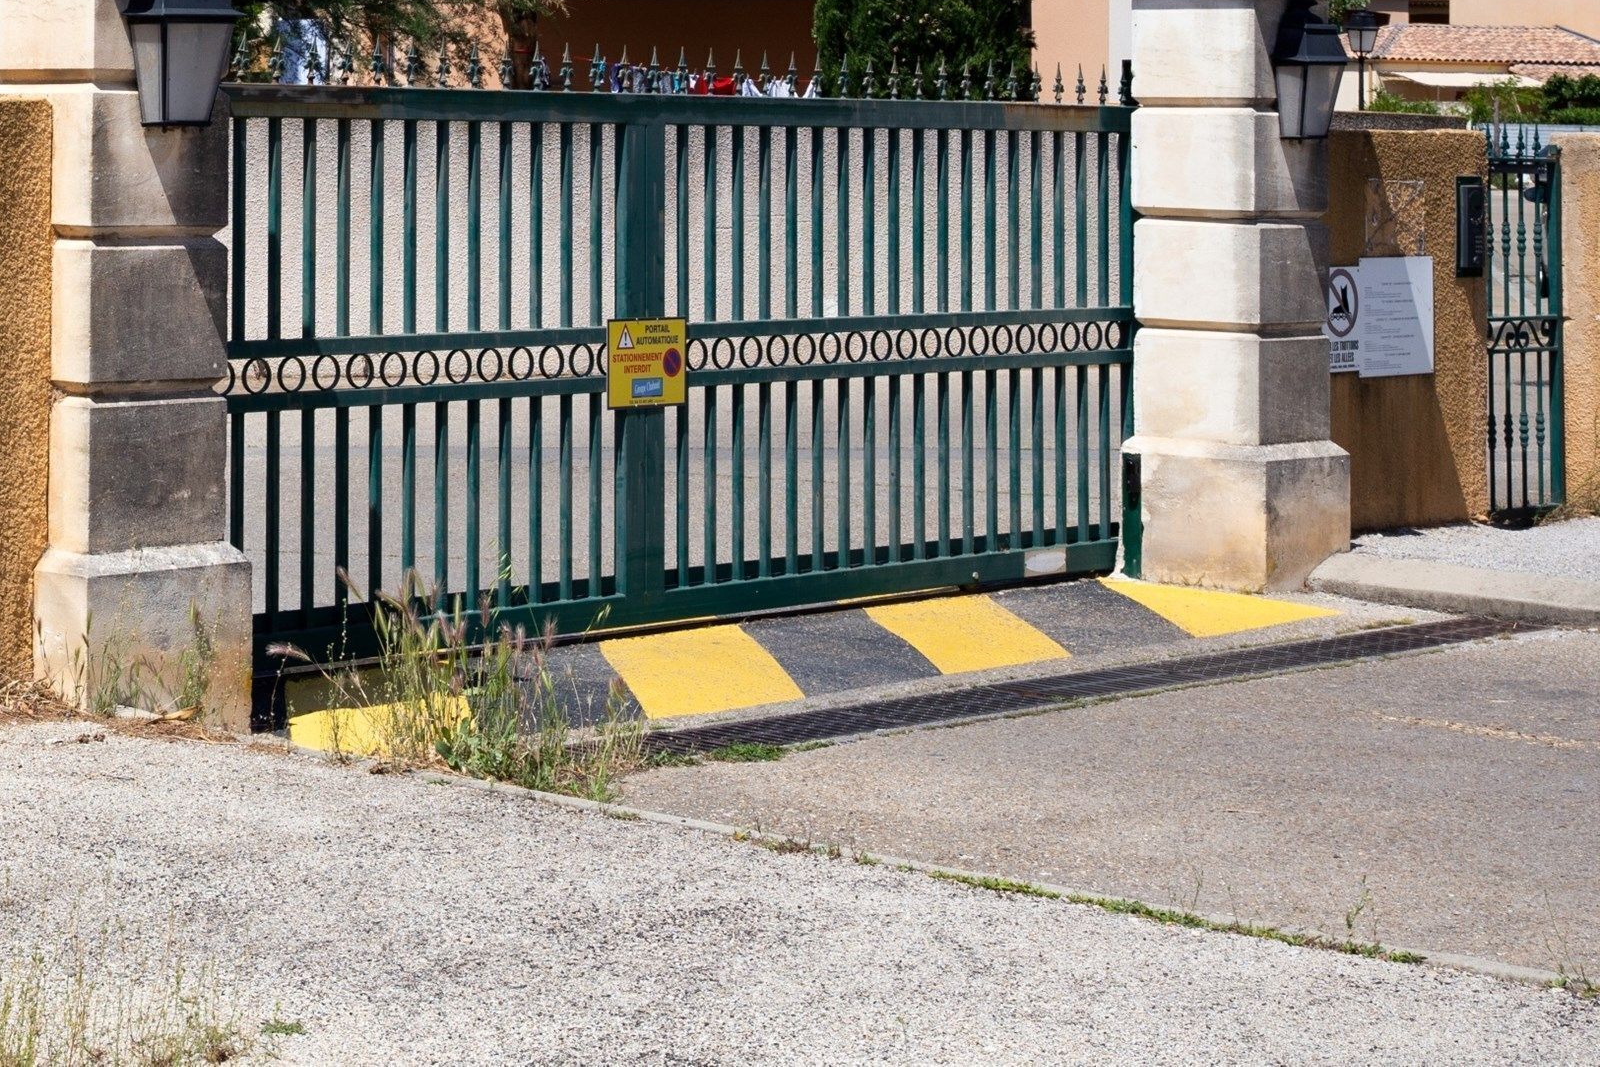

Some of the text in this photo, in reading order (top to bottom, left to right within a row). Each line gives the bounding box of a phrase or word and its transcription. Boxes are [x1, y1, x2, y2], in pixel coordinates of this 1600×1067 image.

[645, 325, 670, 333] PORTAIL
[636, 335, 678, 345] AUTOMATIQUE
[613, 353, 662, 363] STATIONNEMENT
[624, 365, 651, 373] INTERDIT
